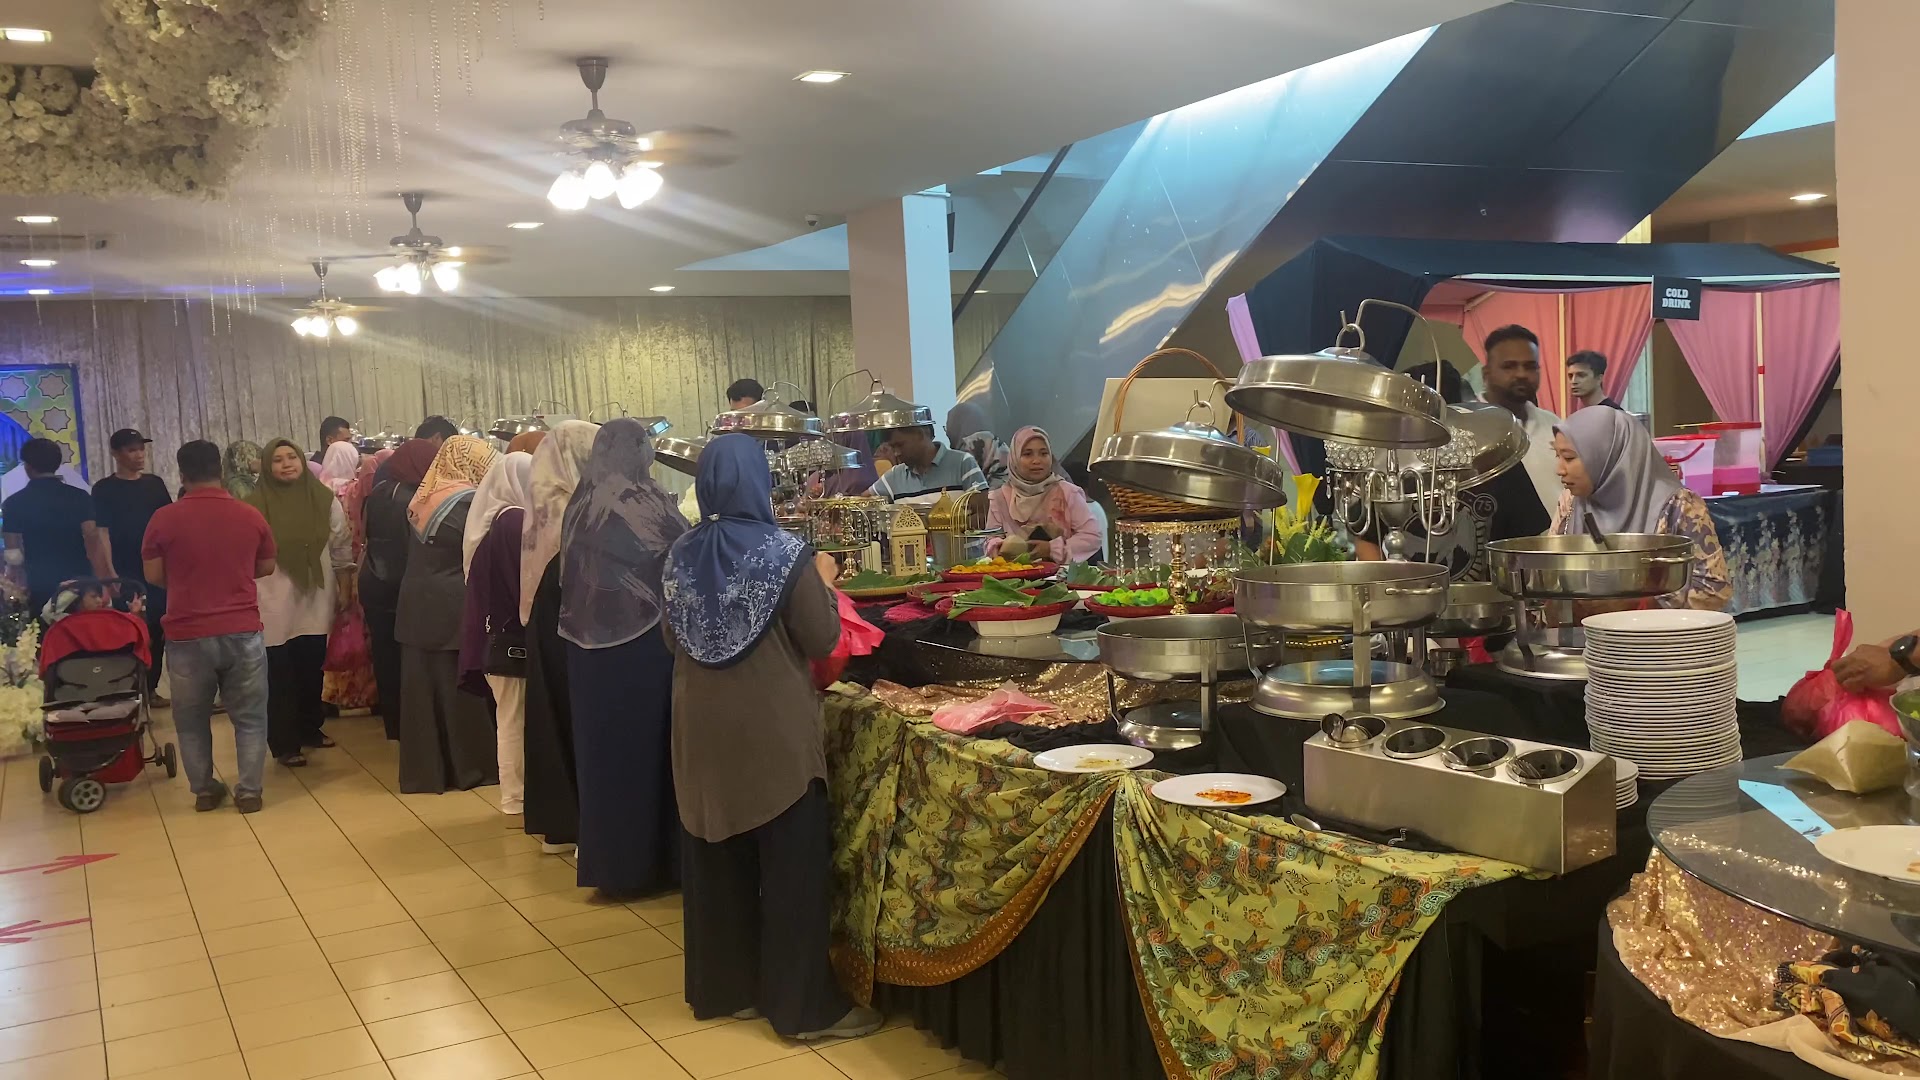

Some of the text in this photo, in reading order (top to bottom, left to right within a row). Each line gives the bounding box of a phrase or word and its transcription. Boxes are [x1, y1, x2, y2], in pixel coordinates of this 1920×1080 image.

[1666, 288, 1689, 298] COLD
[1662, 298, 1691, 309] DRINK
[1477, 500, 1492, 511] 75
